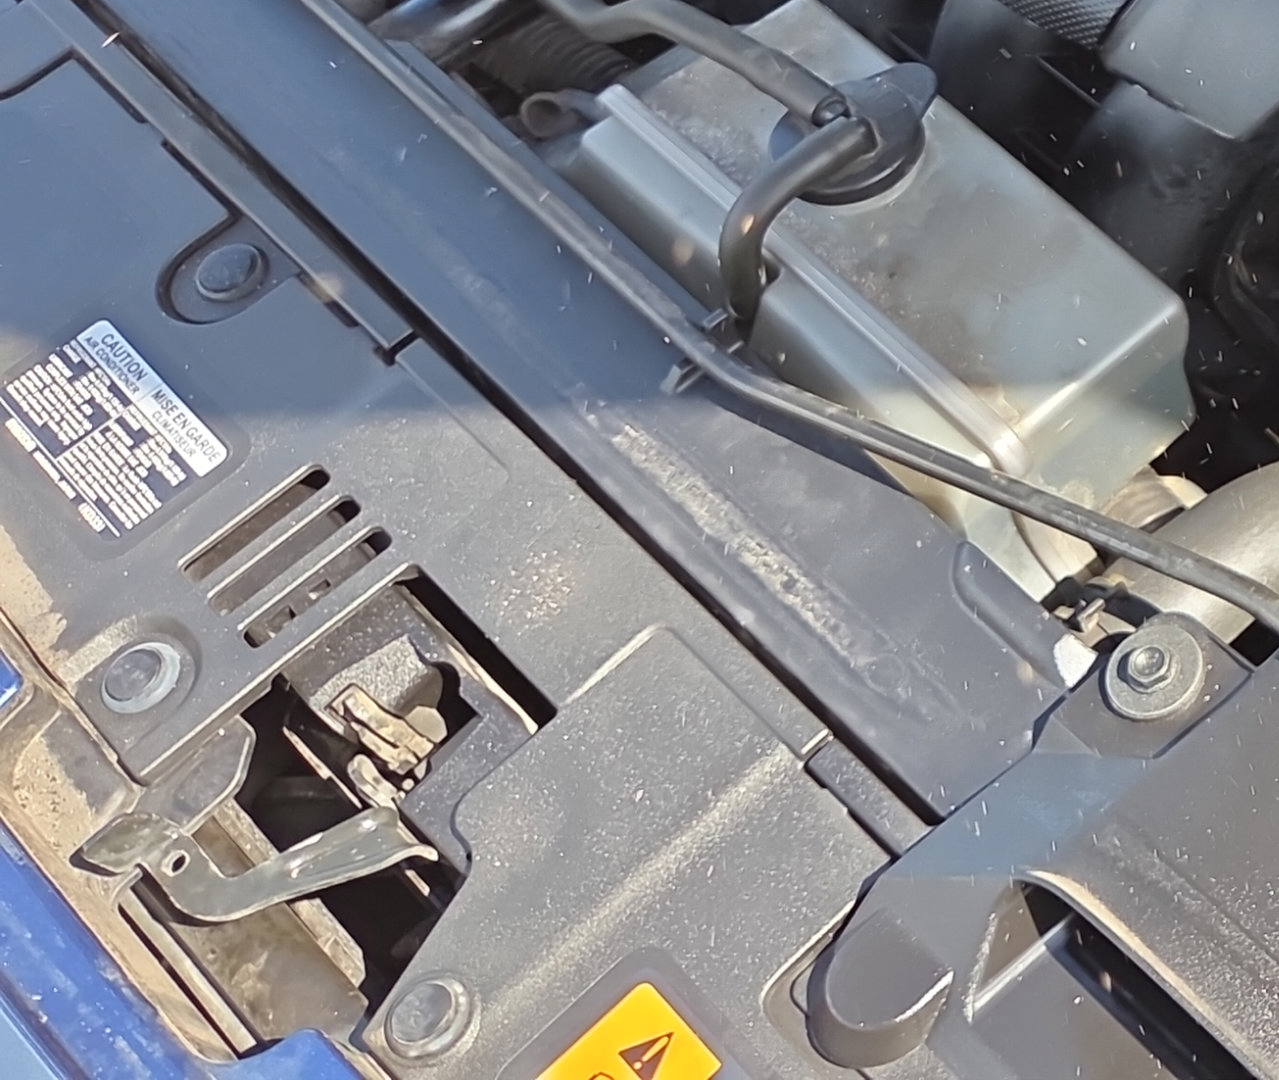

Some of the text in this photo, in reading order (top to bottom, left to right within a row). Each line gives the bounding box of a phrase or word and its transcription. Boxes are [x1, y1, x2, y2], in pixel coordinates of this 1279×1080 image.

[83, 335, 141, 395] AIR CONDITIONER
[100, 333, 148, 382] CAUTION
[150, 388, 222, 463] MISE EN GARDE
